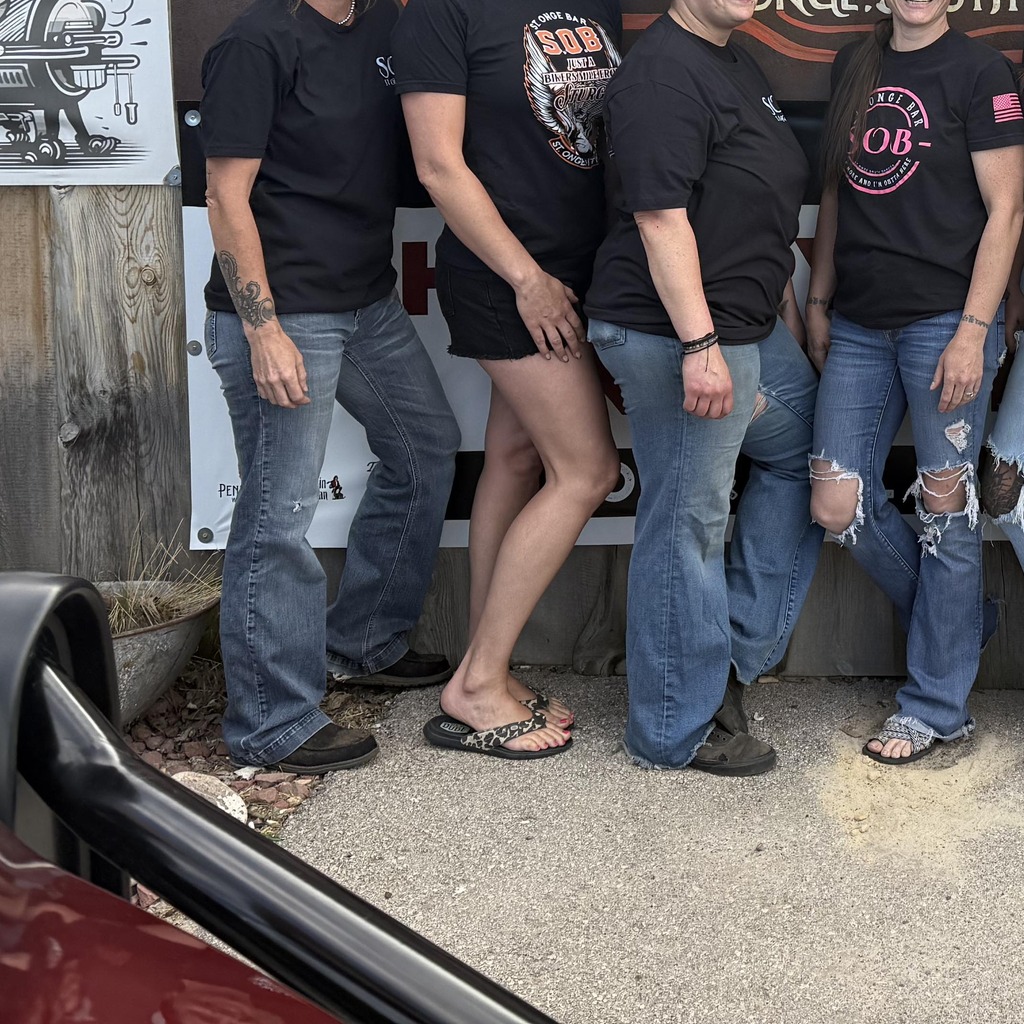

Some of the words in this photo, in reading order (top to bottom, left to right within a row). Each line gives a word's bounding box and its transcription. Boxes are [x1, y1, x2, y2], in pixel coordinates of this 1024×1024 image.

[565, 12, 587, 25] BAR
[567, 57, 587, 71] JUST
[588, 56, 596, 68] A
[554, 82, 607, 111] STURG
[906, 102, 924, 127] BAR
[859, 177, 872, 187] AND
